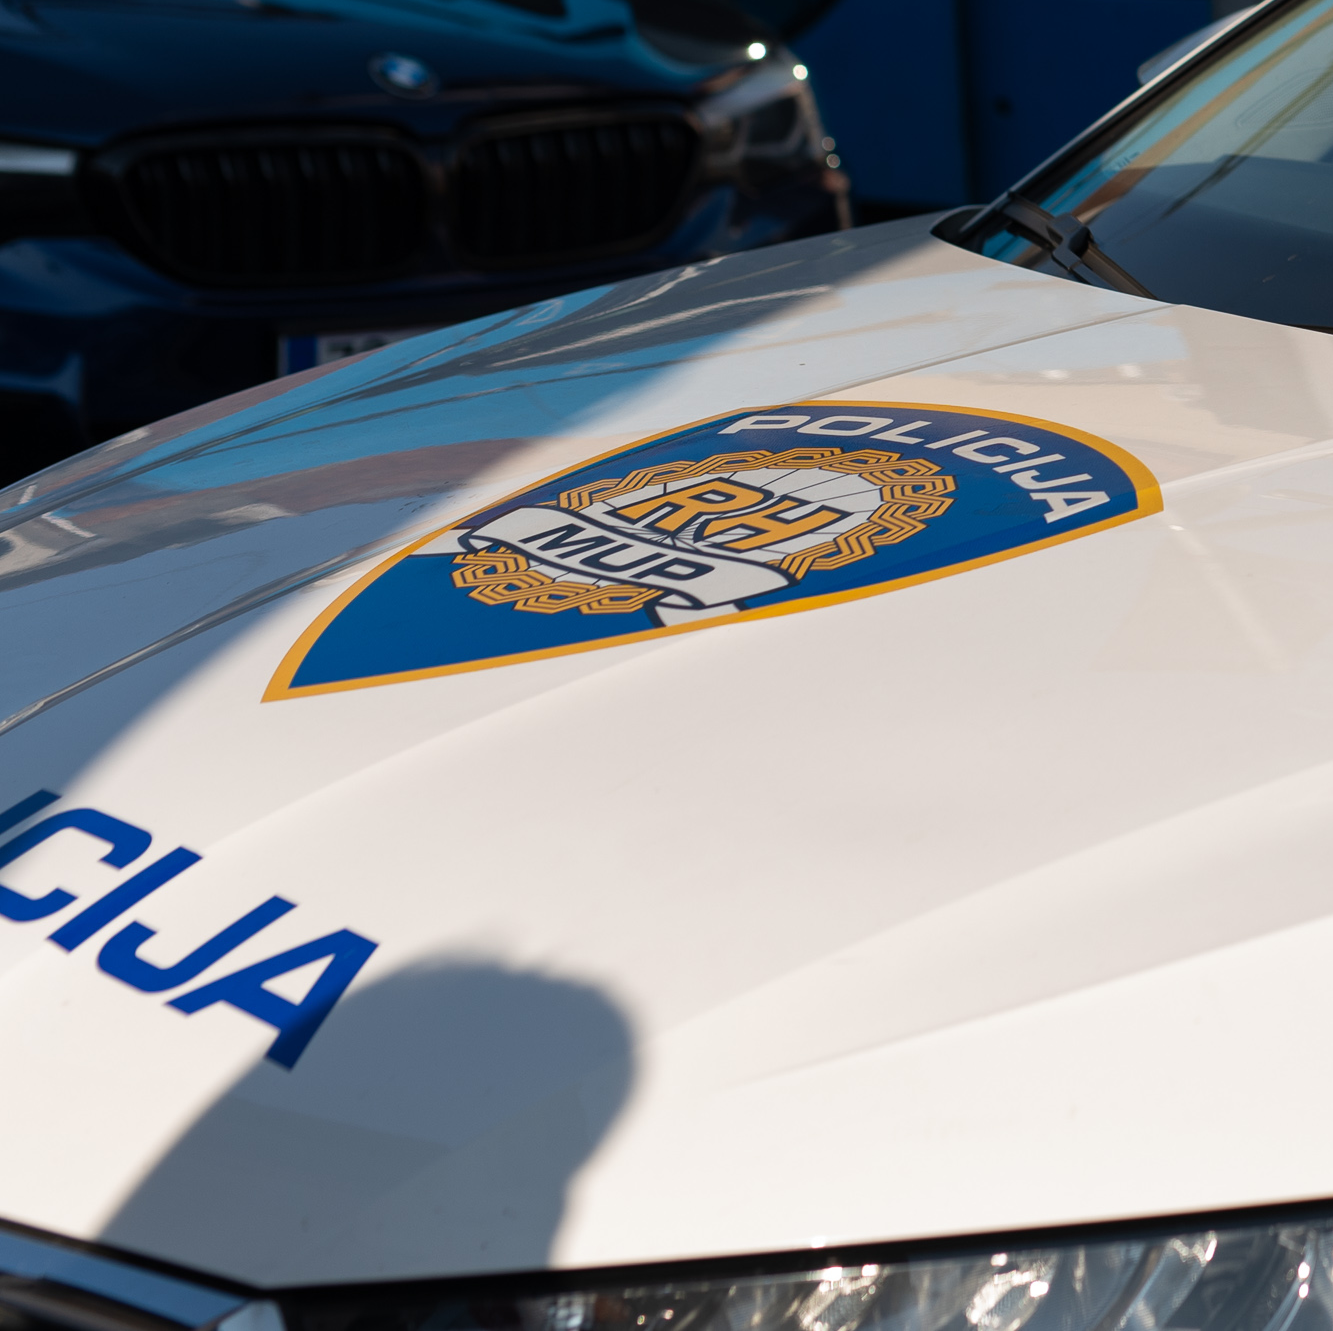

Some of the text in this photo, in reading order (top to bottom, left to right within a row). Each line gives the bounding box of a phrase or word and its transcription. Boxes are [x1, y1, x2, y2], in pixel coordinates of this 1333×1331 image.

[716, 414, 1112, 525] POLICIJA
[517, 523, 716, 581] MUP
[602, 477, 854, 554] RH
